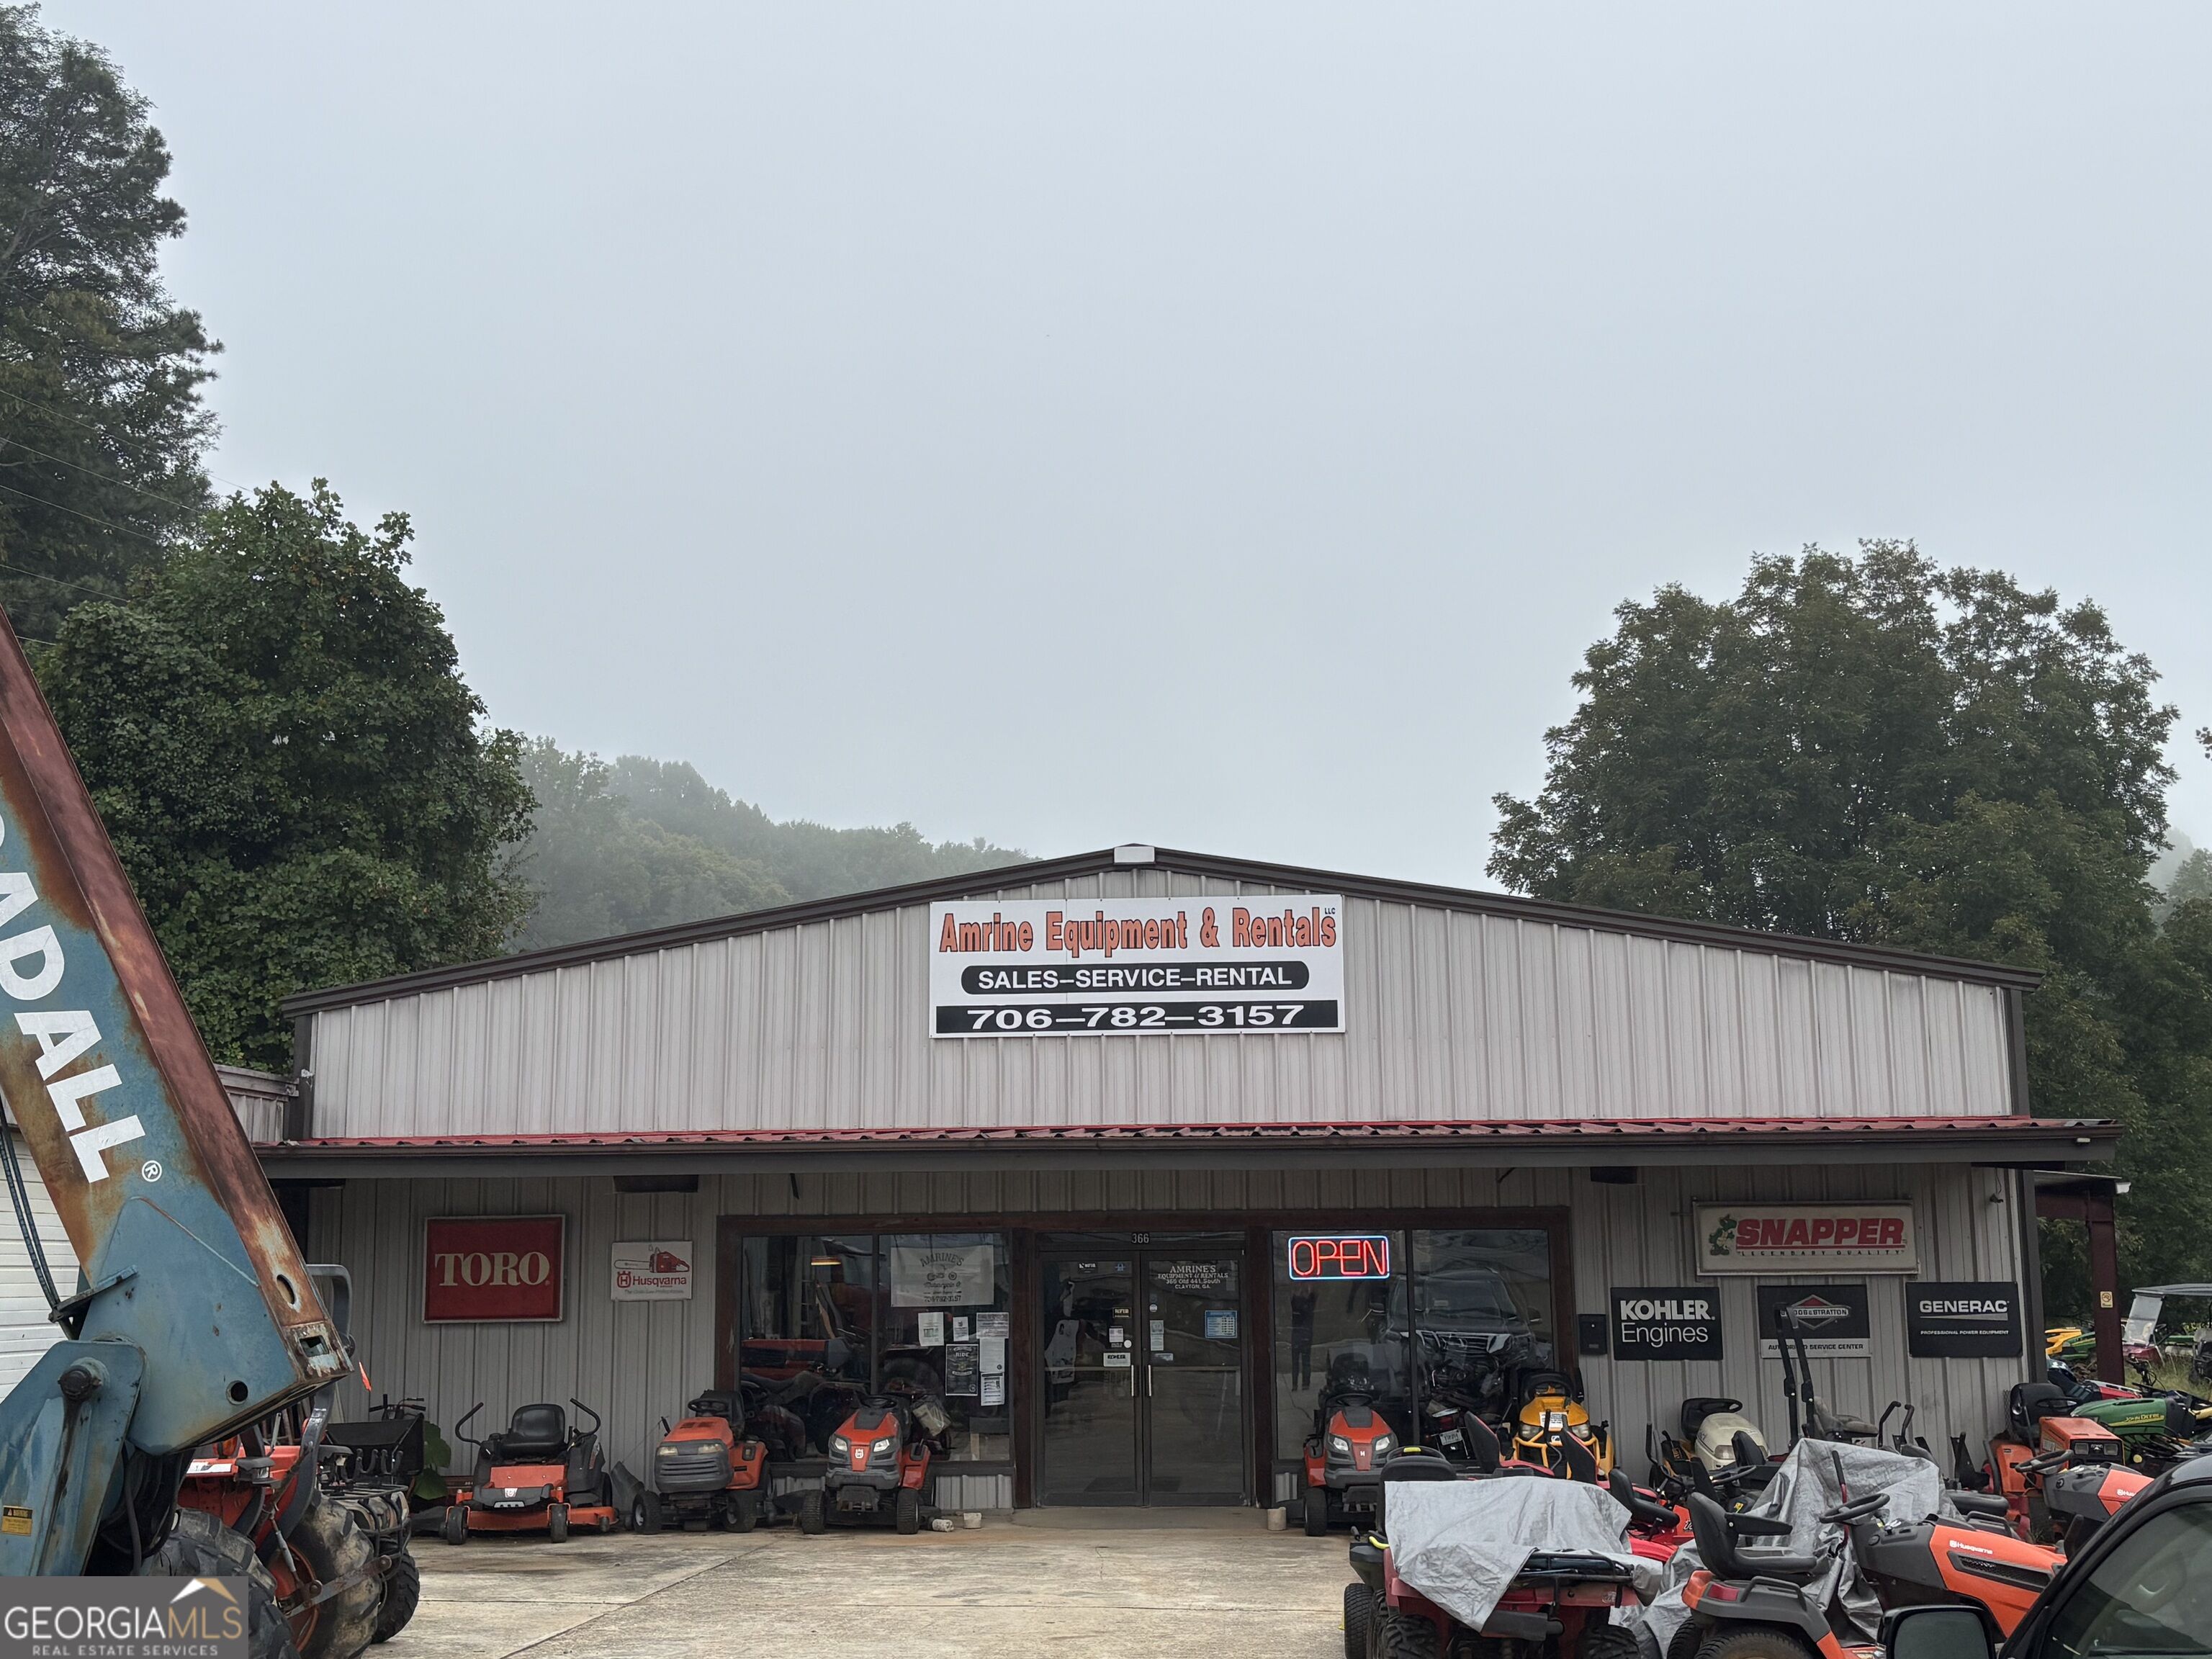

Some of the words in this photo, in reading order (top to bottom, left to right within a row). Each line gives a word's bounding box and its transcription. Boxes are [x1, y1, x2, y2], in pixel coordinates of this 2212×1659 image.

[939, 912, 1034, 953] Amrine
[1046, 910, 1187, 958] Equipment
[1200, 907, 1220, 948] &
[1232, 907, 1336, 948] Rentals
[967, 1005, 1305, 1030] 706-782-3157
[1131, 1233, 1149, 1244] 366
[1736, 1218, 1905, 1246] SNAPPER
[435, 1251, 550, 1286] TORO
[1292, 1240, 1385, 1275] OPEN
[633, 1275, 687, 1287] Husqvarna
[1620, 1300, 1712, 1320] KOHLER
[1920, 1300, 2008, 1313] GENERAC
[1622, 1322, 1709, 1347] Engines
